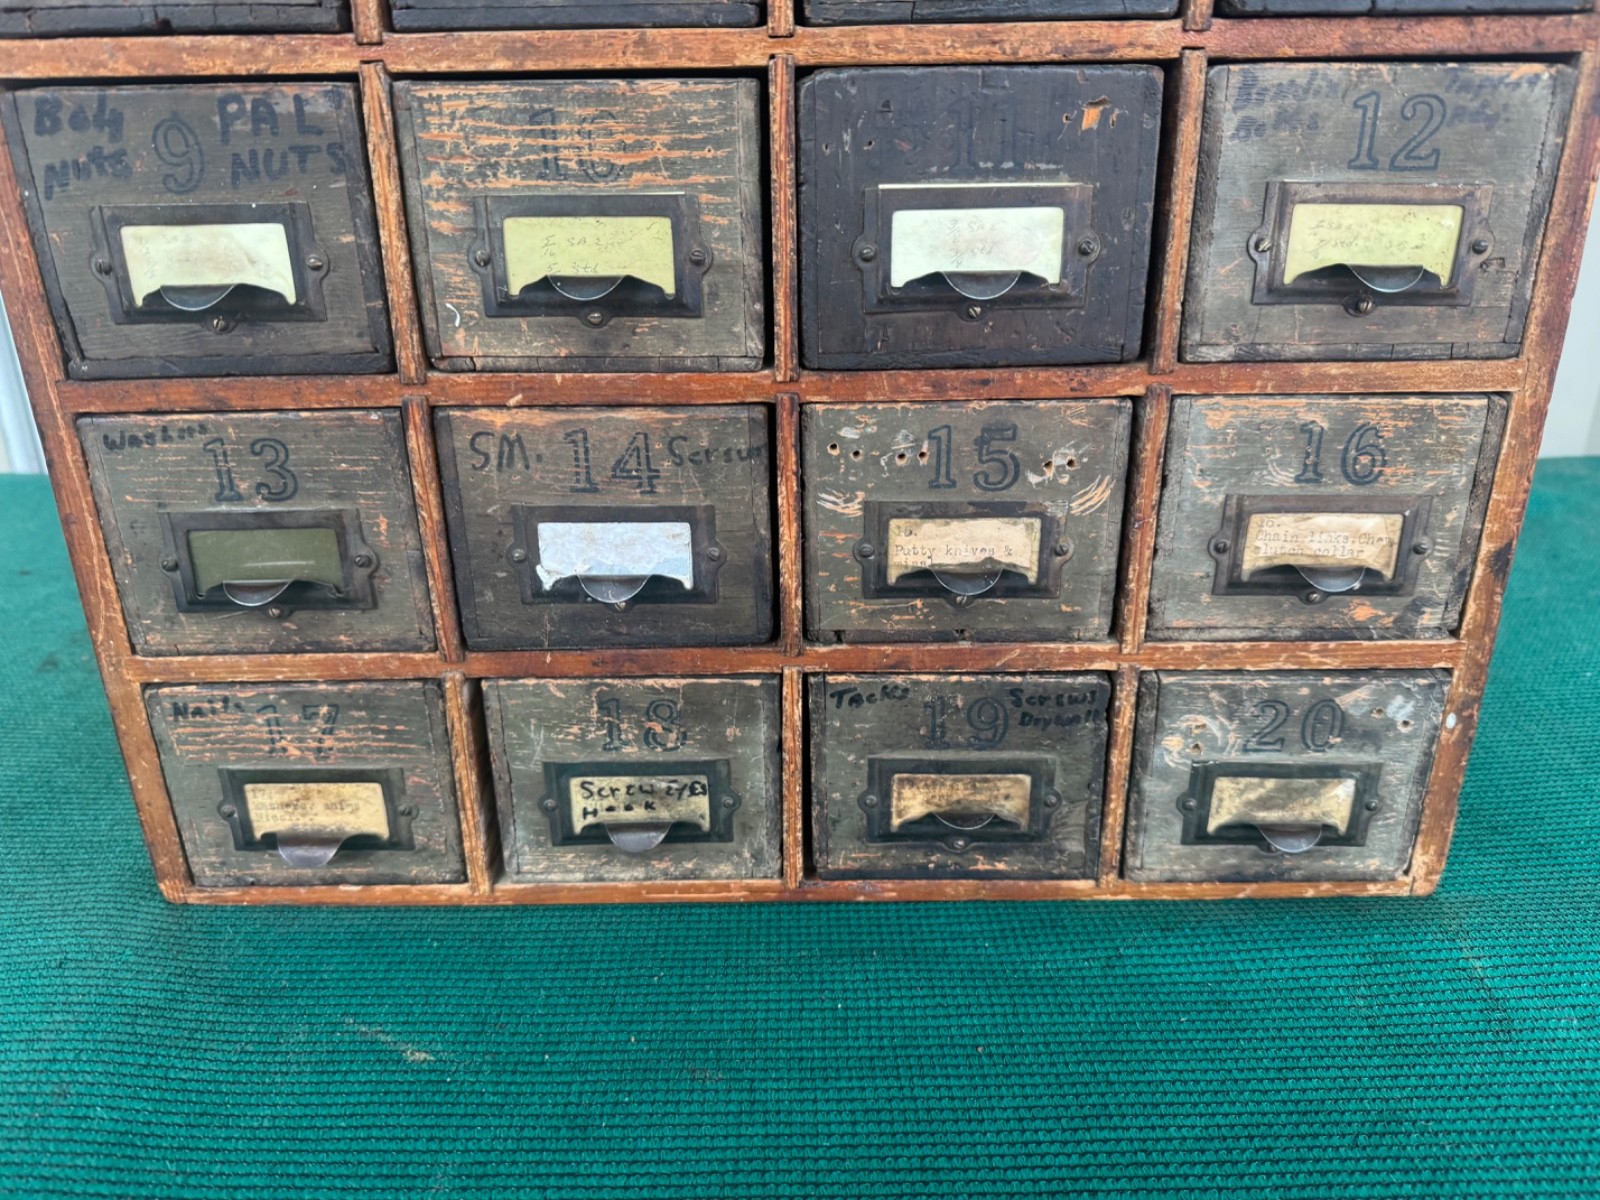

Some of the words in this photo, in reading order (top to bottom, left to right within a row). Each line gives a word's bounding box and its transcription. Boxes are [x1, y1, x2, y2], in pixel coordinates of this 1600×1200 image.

[217, 92, 324, 145] PAL
[529, 107, 626, 183] 10
[1347, 90, 1446, 171] 12
[152, 112, 204, 194] 9
[231, 142, 346, 190] NUTS
[203, 437, 298, 501] 13
[469, 431, 543, 473] SM.
[563, 428, 660, 494] 14
[928, 423, 1020, 492] 15
[1294, 421, 1388, 486] 16
[1003, 545, 1013, 557] &
[256, 703, 340, 757] 17
[600, 698, 688, 751] 18
[923, 695, 1009, 751] 19
[1244, 699, 1346, 752] 20
